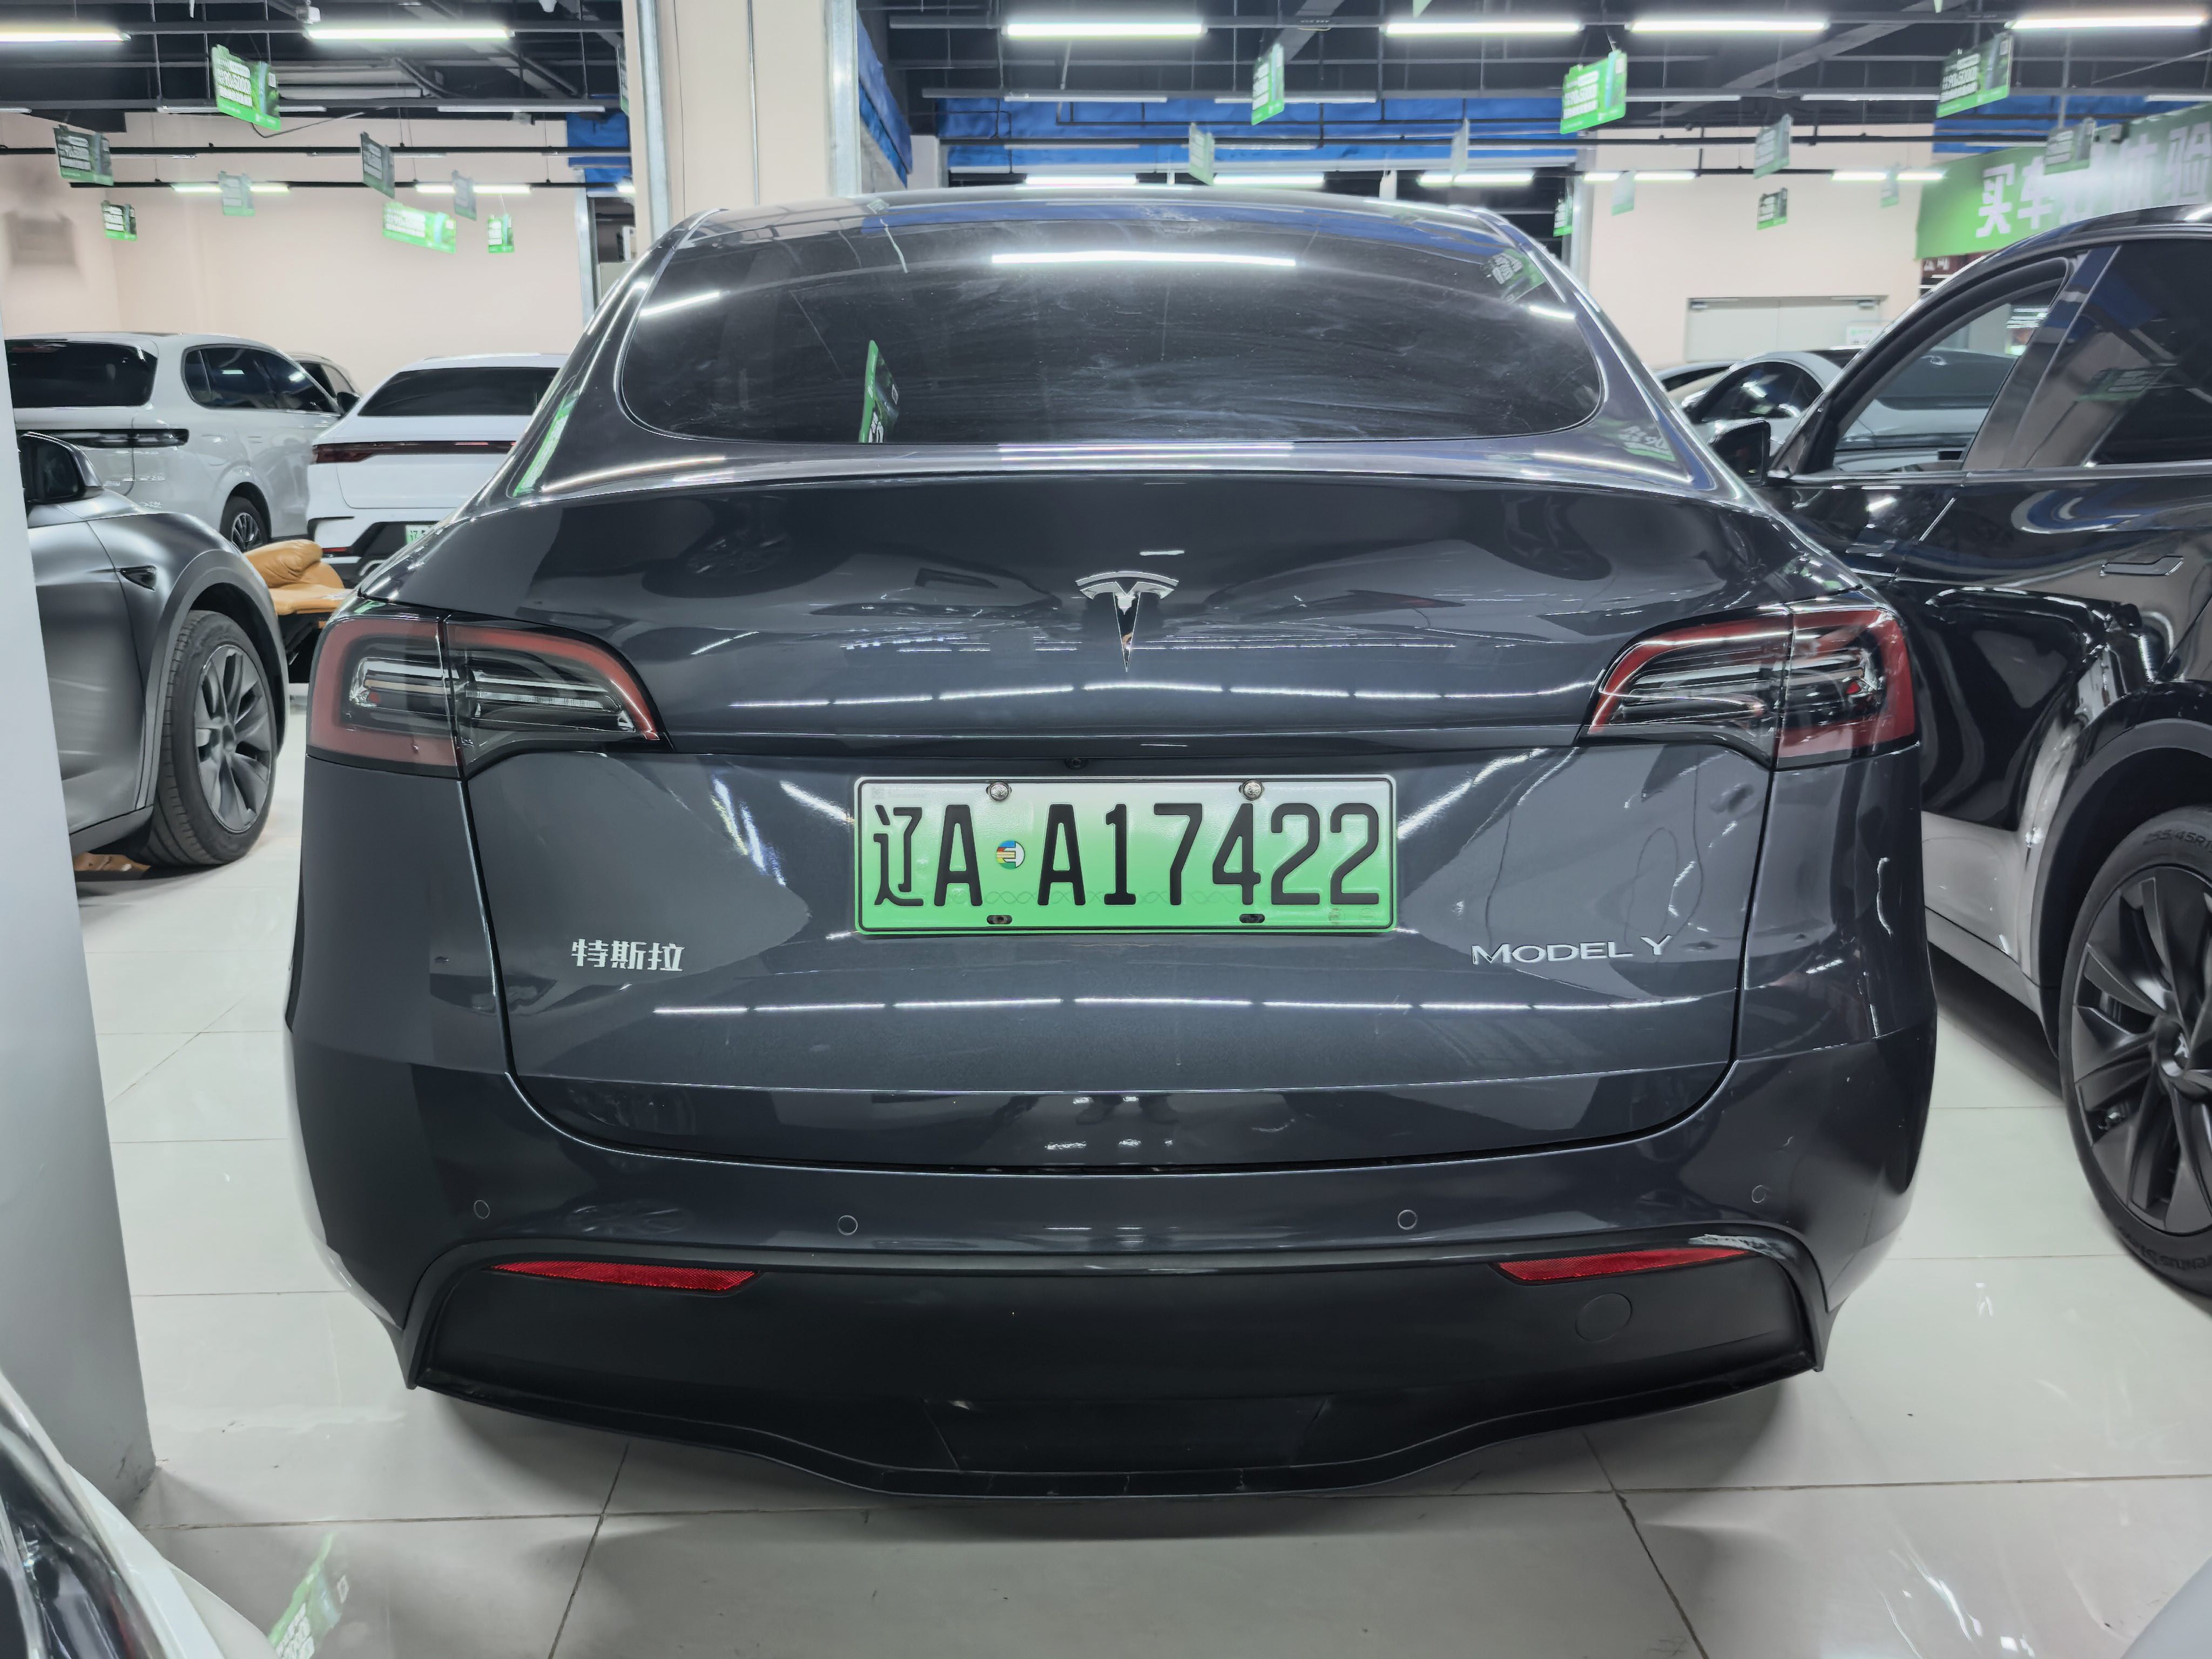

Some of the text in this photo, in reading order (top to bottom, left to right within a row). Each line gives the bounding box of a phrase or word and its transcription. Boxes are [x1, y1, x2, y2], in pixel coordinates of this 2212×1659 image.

[873, 802, 1379, 906] 辽A A17422
[571, 939, 685, 972] 特斯拉
[1471, 935, 1673, 966] MODEL Y
